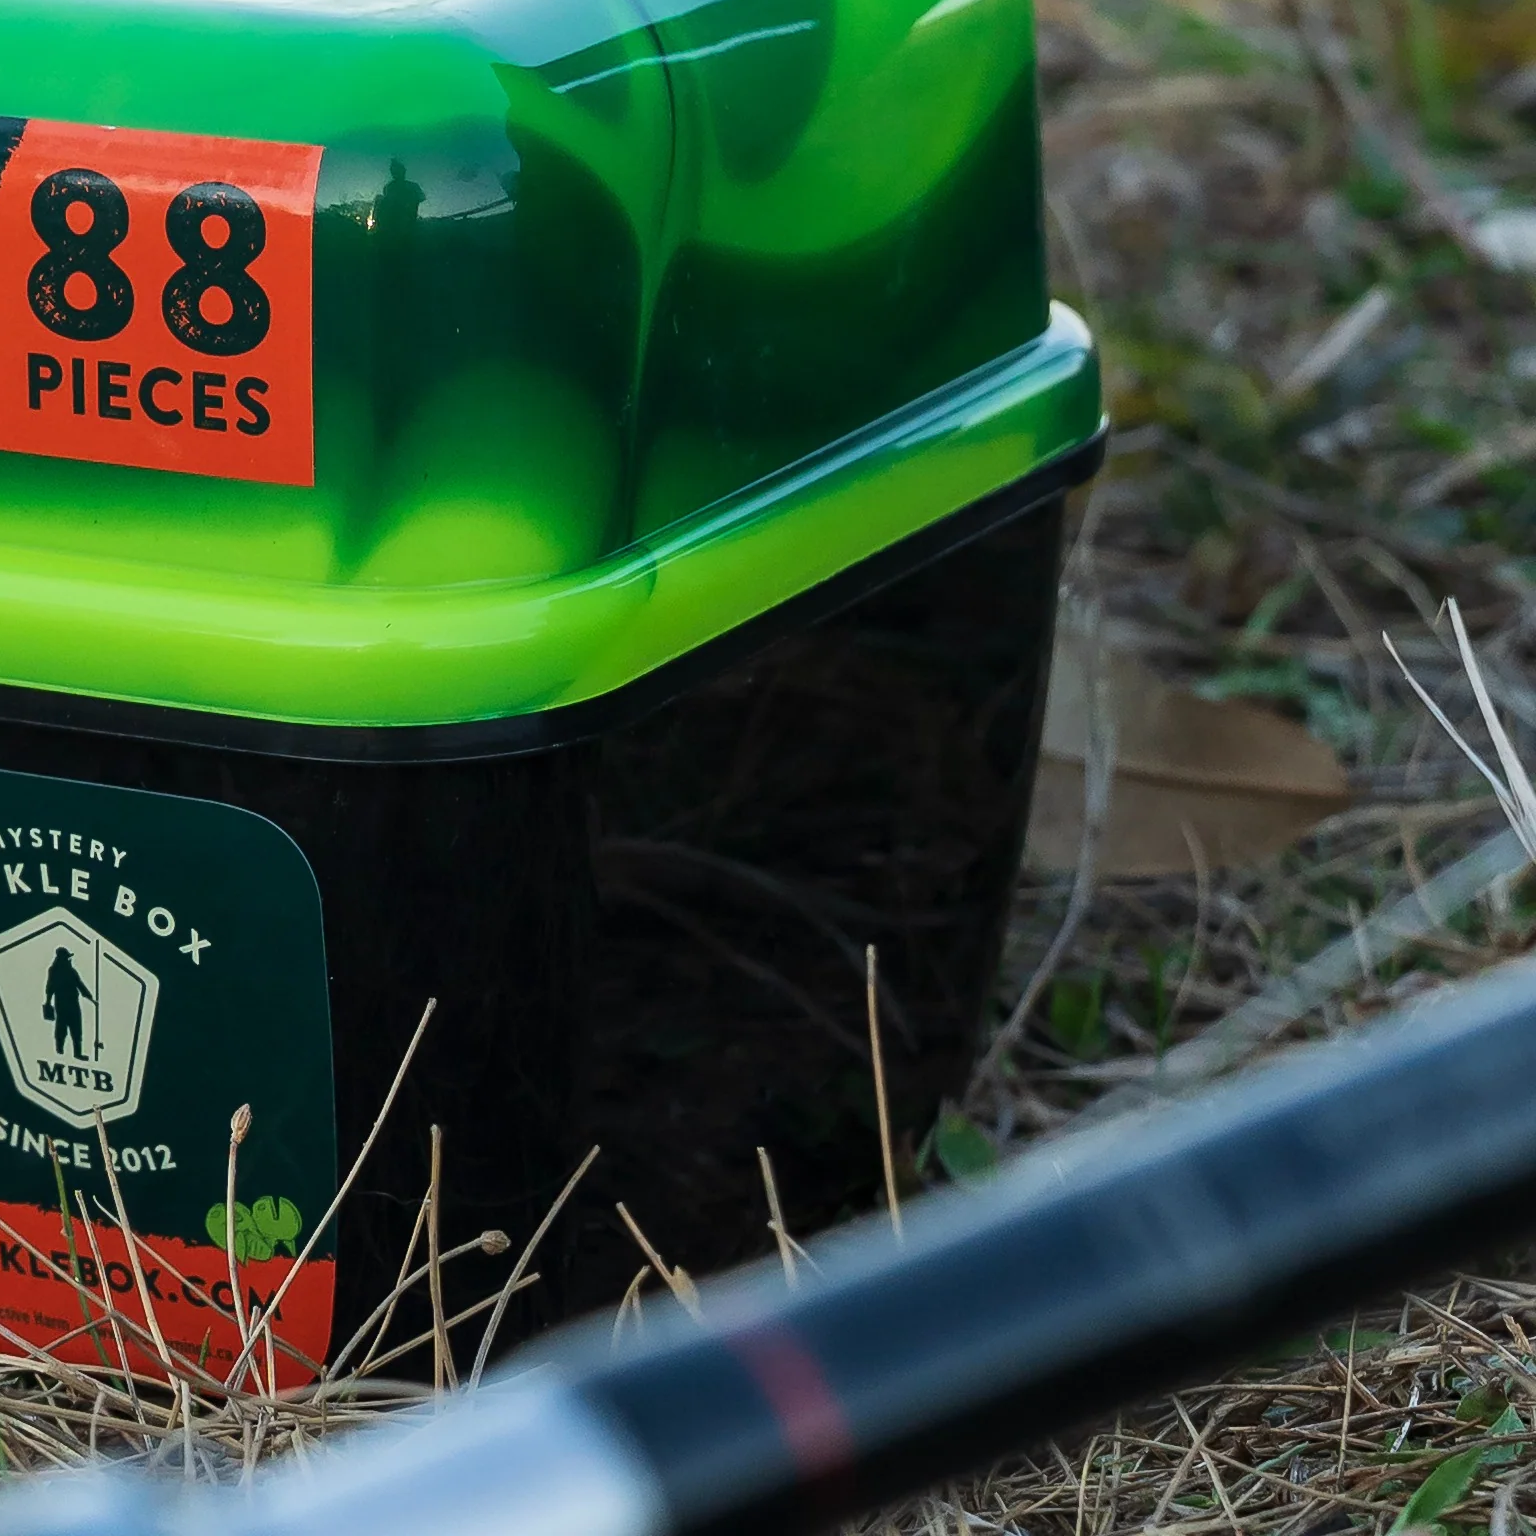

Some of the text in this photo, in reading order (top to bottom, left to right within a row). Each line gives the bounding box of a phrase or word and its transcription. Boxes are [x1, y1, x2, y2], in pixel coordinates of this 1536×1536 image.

[26, 167, 272, 356] 88
[27, 352, 272, 436] PIECES
[114, 884, 212, 965] BOX
[37, 1060, 114, 1093] MTB
[105, 1144, 177, 1173] 2012
